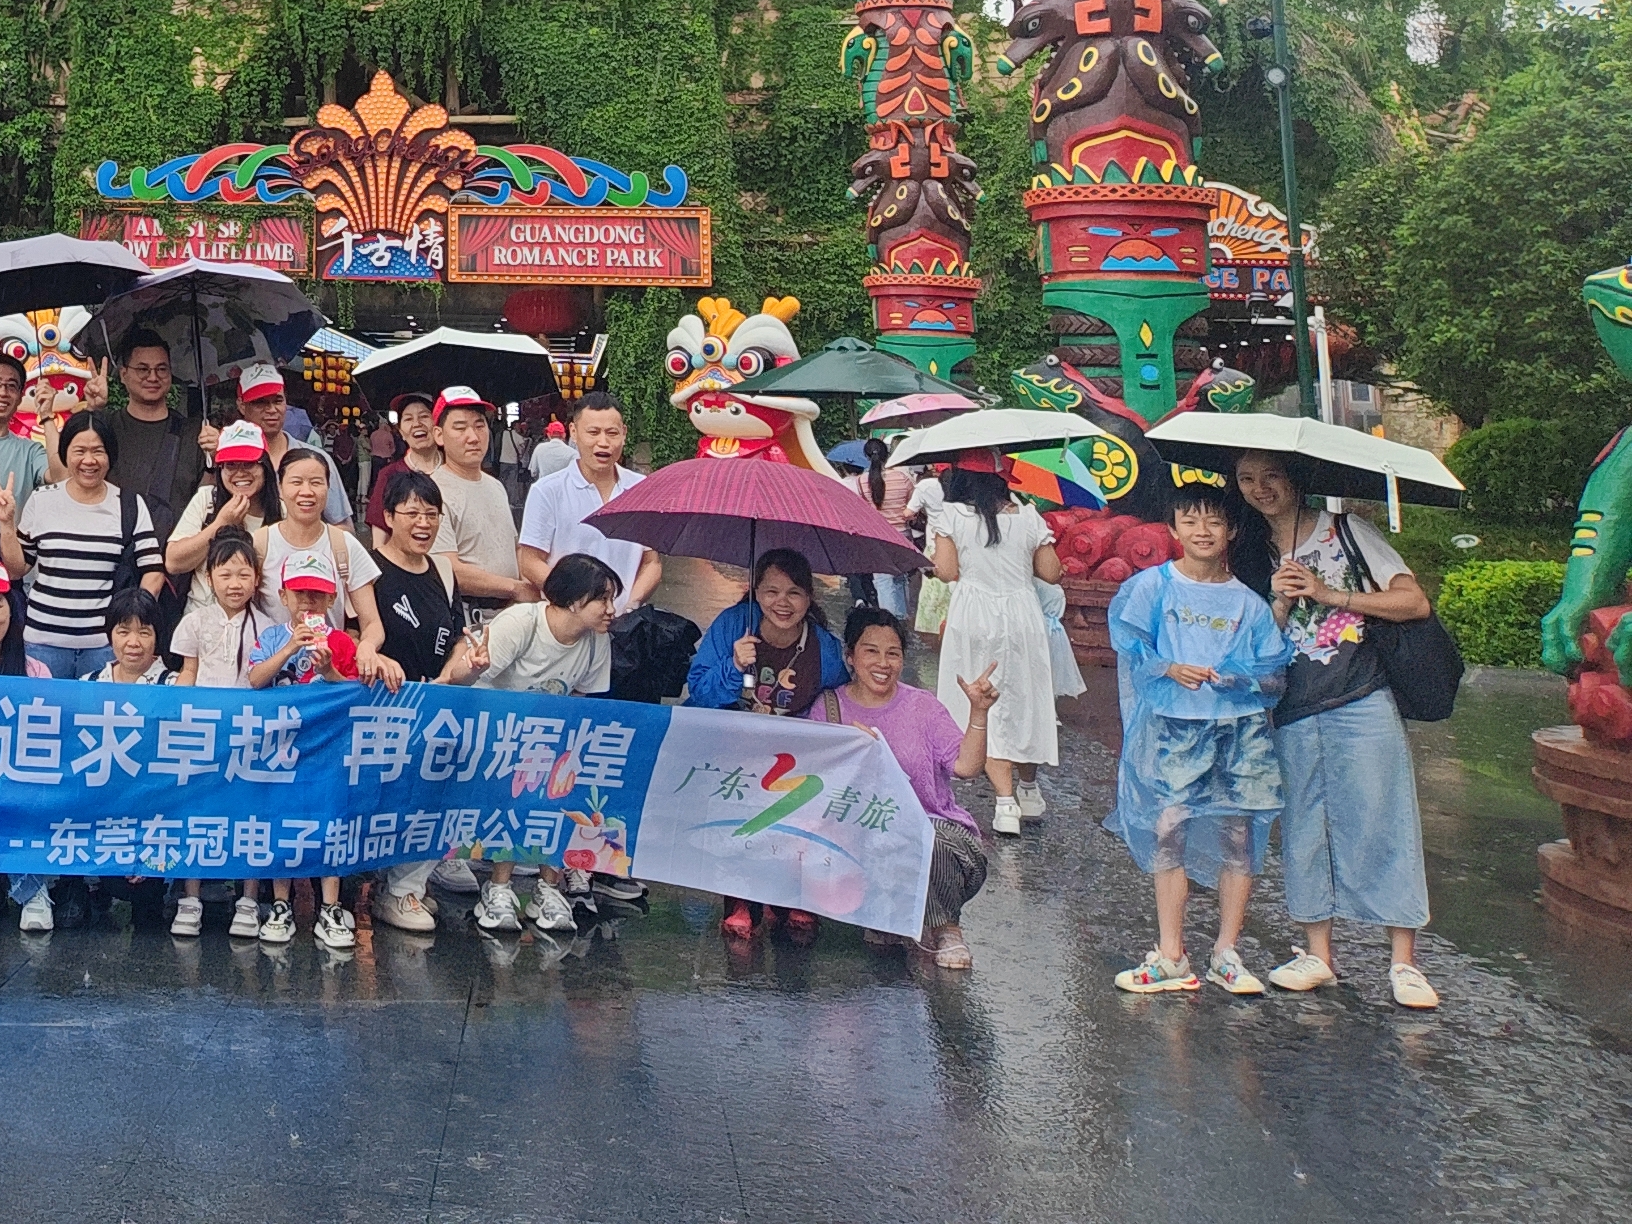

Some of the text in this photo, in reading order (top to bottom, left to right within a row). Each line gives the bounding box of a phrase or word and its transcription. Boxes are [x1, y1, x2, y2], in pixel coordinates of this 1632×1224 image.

[135, 218, 149, 237] A
[153, 219, 206, 238] MST
[510, 224, 645, 245] GUANGDONG
[180, 243, 195, 259] A
[199, 242, 295, 262] LIFETIME
[317, 216, 445, 273] 千古情
[493, 246, 665, 268] ROMANCE PARK
[342, 703, 637, 790] 再创辉煌
[673, 762, 901, 833] 广东 青旅
